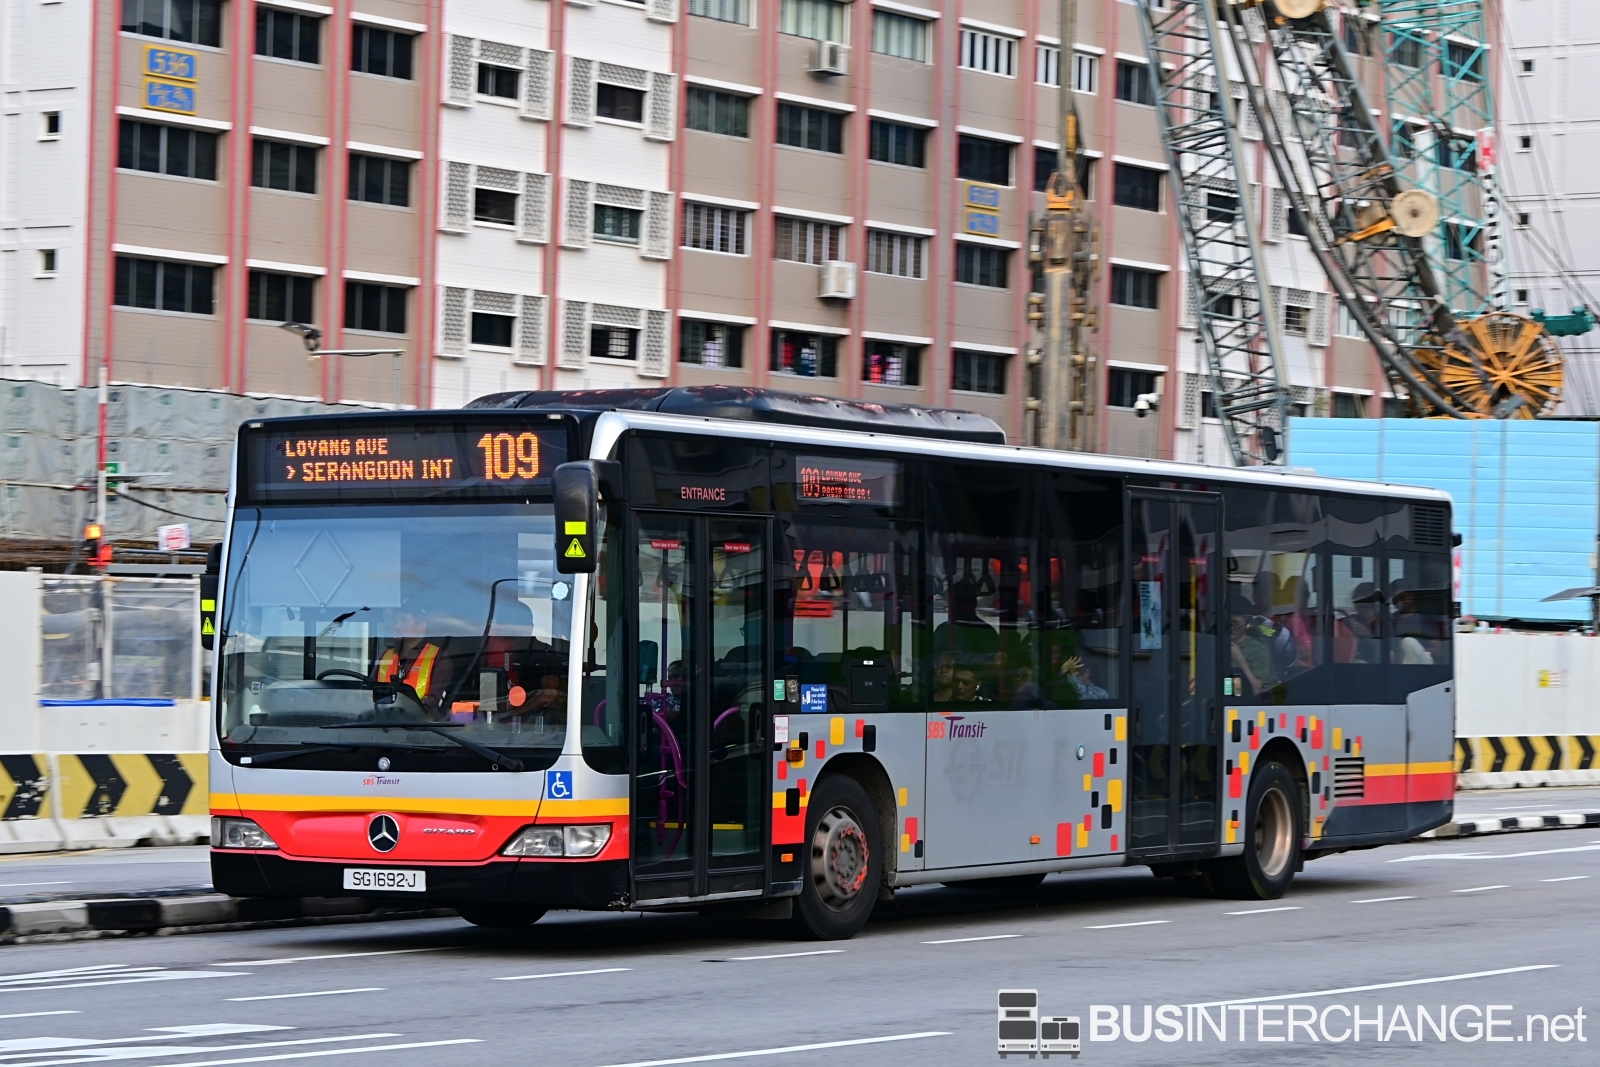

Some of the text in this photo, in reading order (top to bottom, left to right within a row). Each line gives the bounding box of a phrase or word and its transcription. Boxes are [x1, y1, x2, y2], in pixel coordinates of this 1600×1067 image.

[153, 51, 190, 76] 536
[285, 438, 388, 457] LOYANG AVE
[477, 432, 539, 480] 109
[302, 459, 453, 482] SERANGOON INT
[681, 486, 725, 501] ENTRANCE
[801, 467, 820, 498] 109
[927, 716, 988, 741] SBS Transit
[363, 776, 401, 786] SBS Transit
[352, 871, 417, 888] SG1692J
